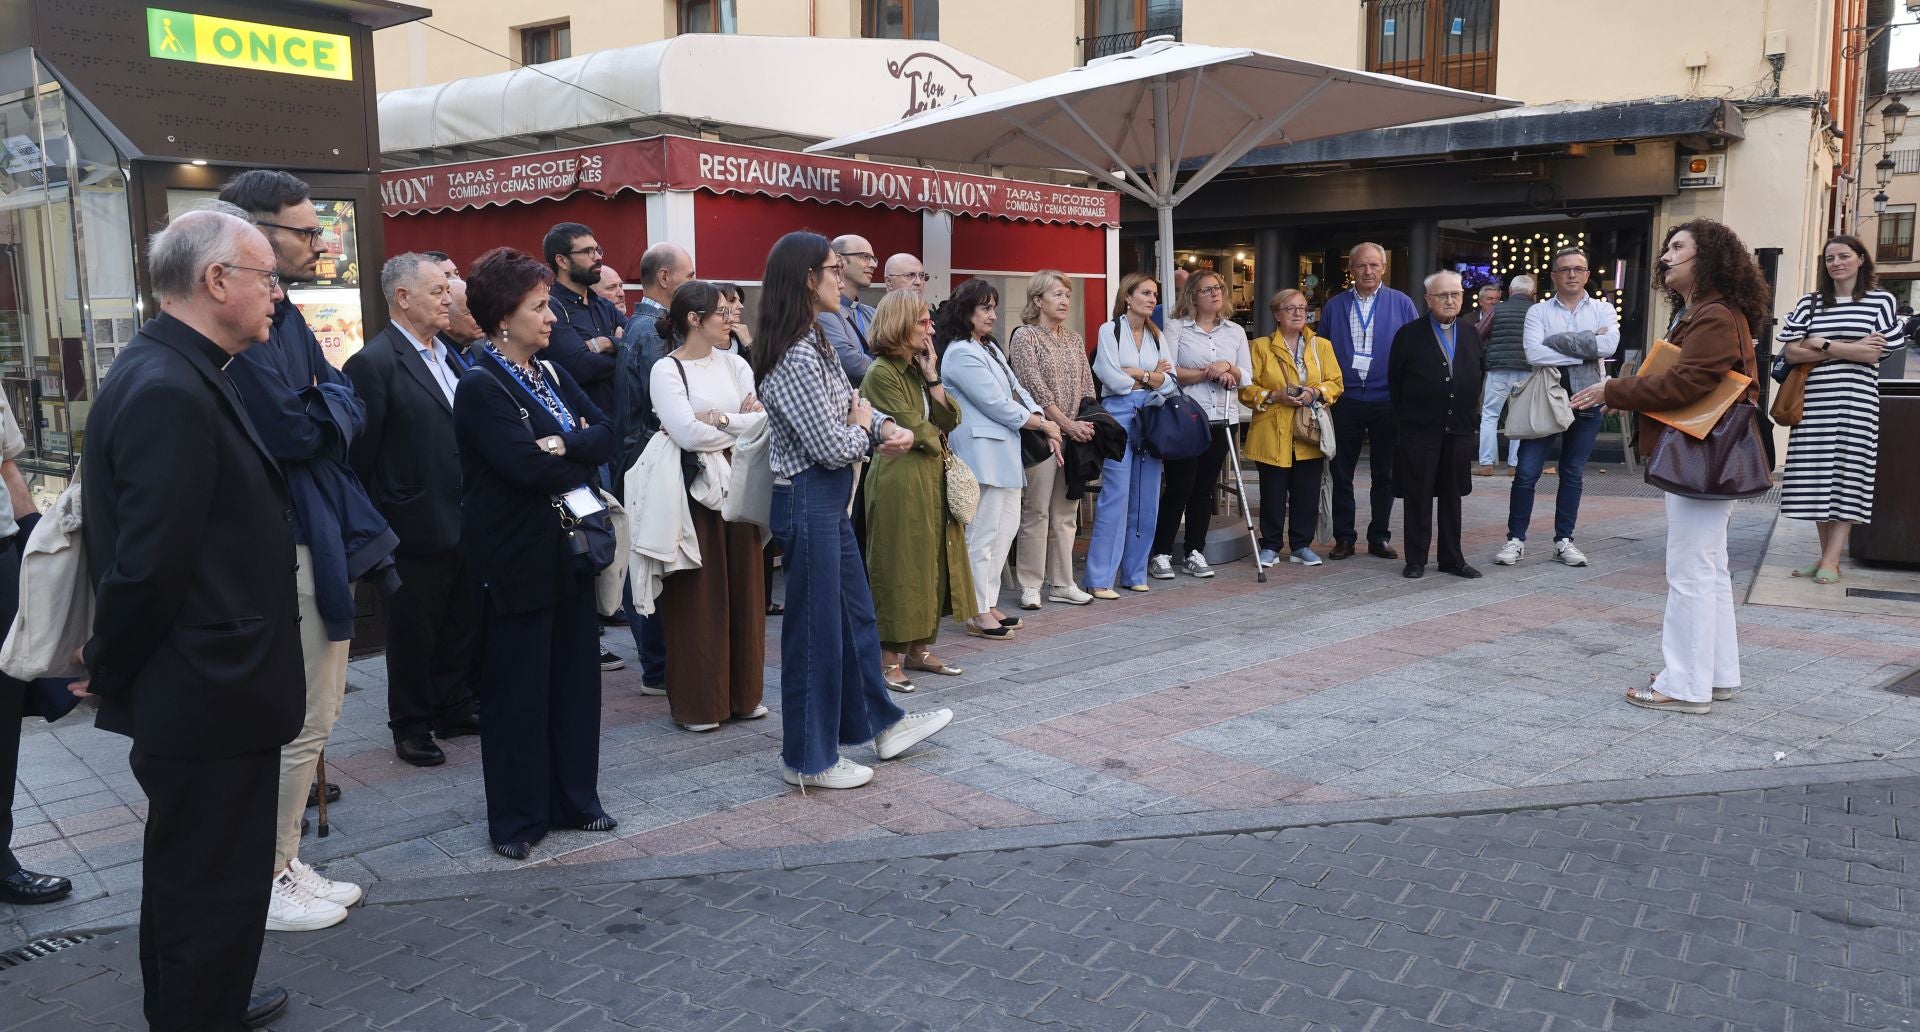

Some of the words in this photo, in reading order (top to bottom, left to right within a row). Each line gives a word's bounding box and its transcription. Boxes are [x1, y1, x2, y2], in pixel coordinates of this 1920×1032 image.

[212, 27, 336, 72] ONCE
[922, 70, 946, 99] don
[447, 168, 495, 186] TAPAS
[448, 182, 491, 200] COMIDAS
[491, 181, 500, 195] Y
[500, 176, 536, 193] CENAS
[699, 153, 841, 193] RESTAURANTE
[852, 168, 913, 201] "DON
[917, 176, 997, 208] JAMON"
[1005, 200, 1038, 213] COMIDAS
[1039, 203, 1044, 213] Y
[1044, 203, 1067, 215] CENAS
[1067, 205, 1106, 217] INFORMALES
[1006, 187, 1041, 201] TAPAS
[1052, 193, 1105, 207] PICOTEOS
